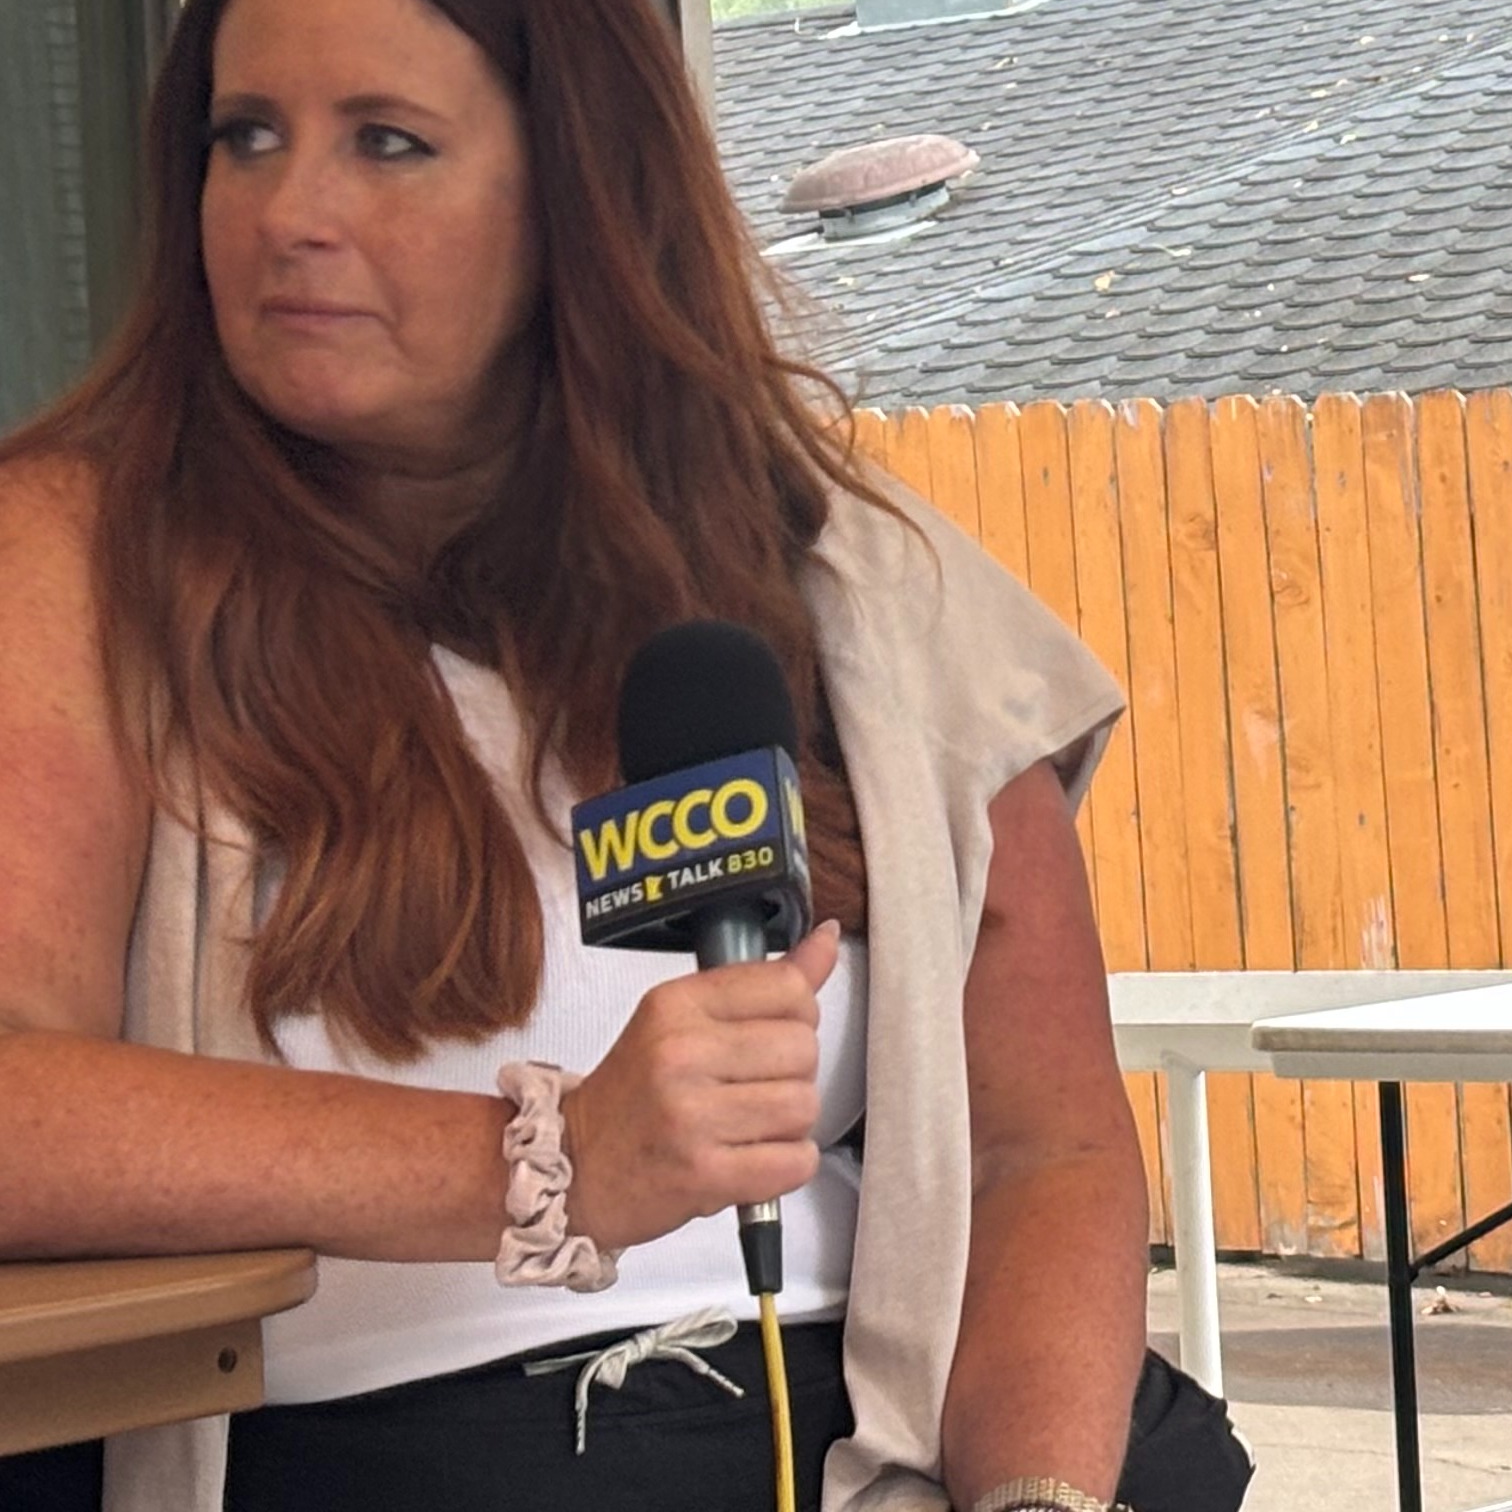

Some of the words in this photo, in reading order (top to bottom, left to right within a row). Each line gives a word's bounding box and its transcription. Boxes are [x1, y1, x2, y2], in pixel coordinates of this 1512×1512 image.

[579, 778, 769, 881] WCCO
[585, 883, 644, 919] NEWS
[667, 857, 725, 890] TALK
[727, 846, 774, 873] 830
